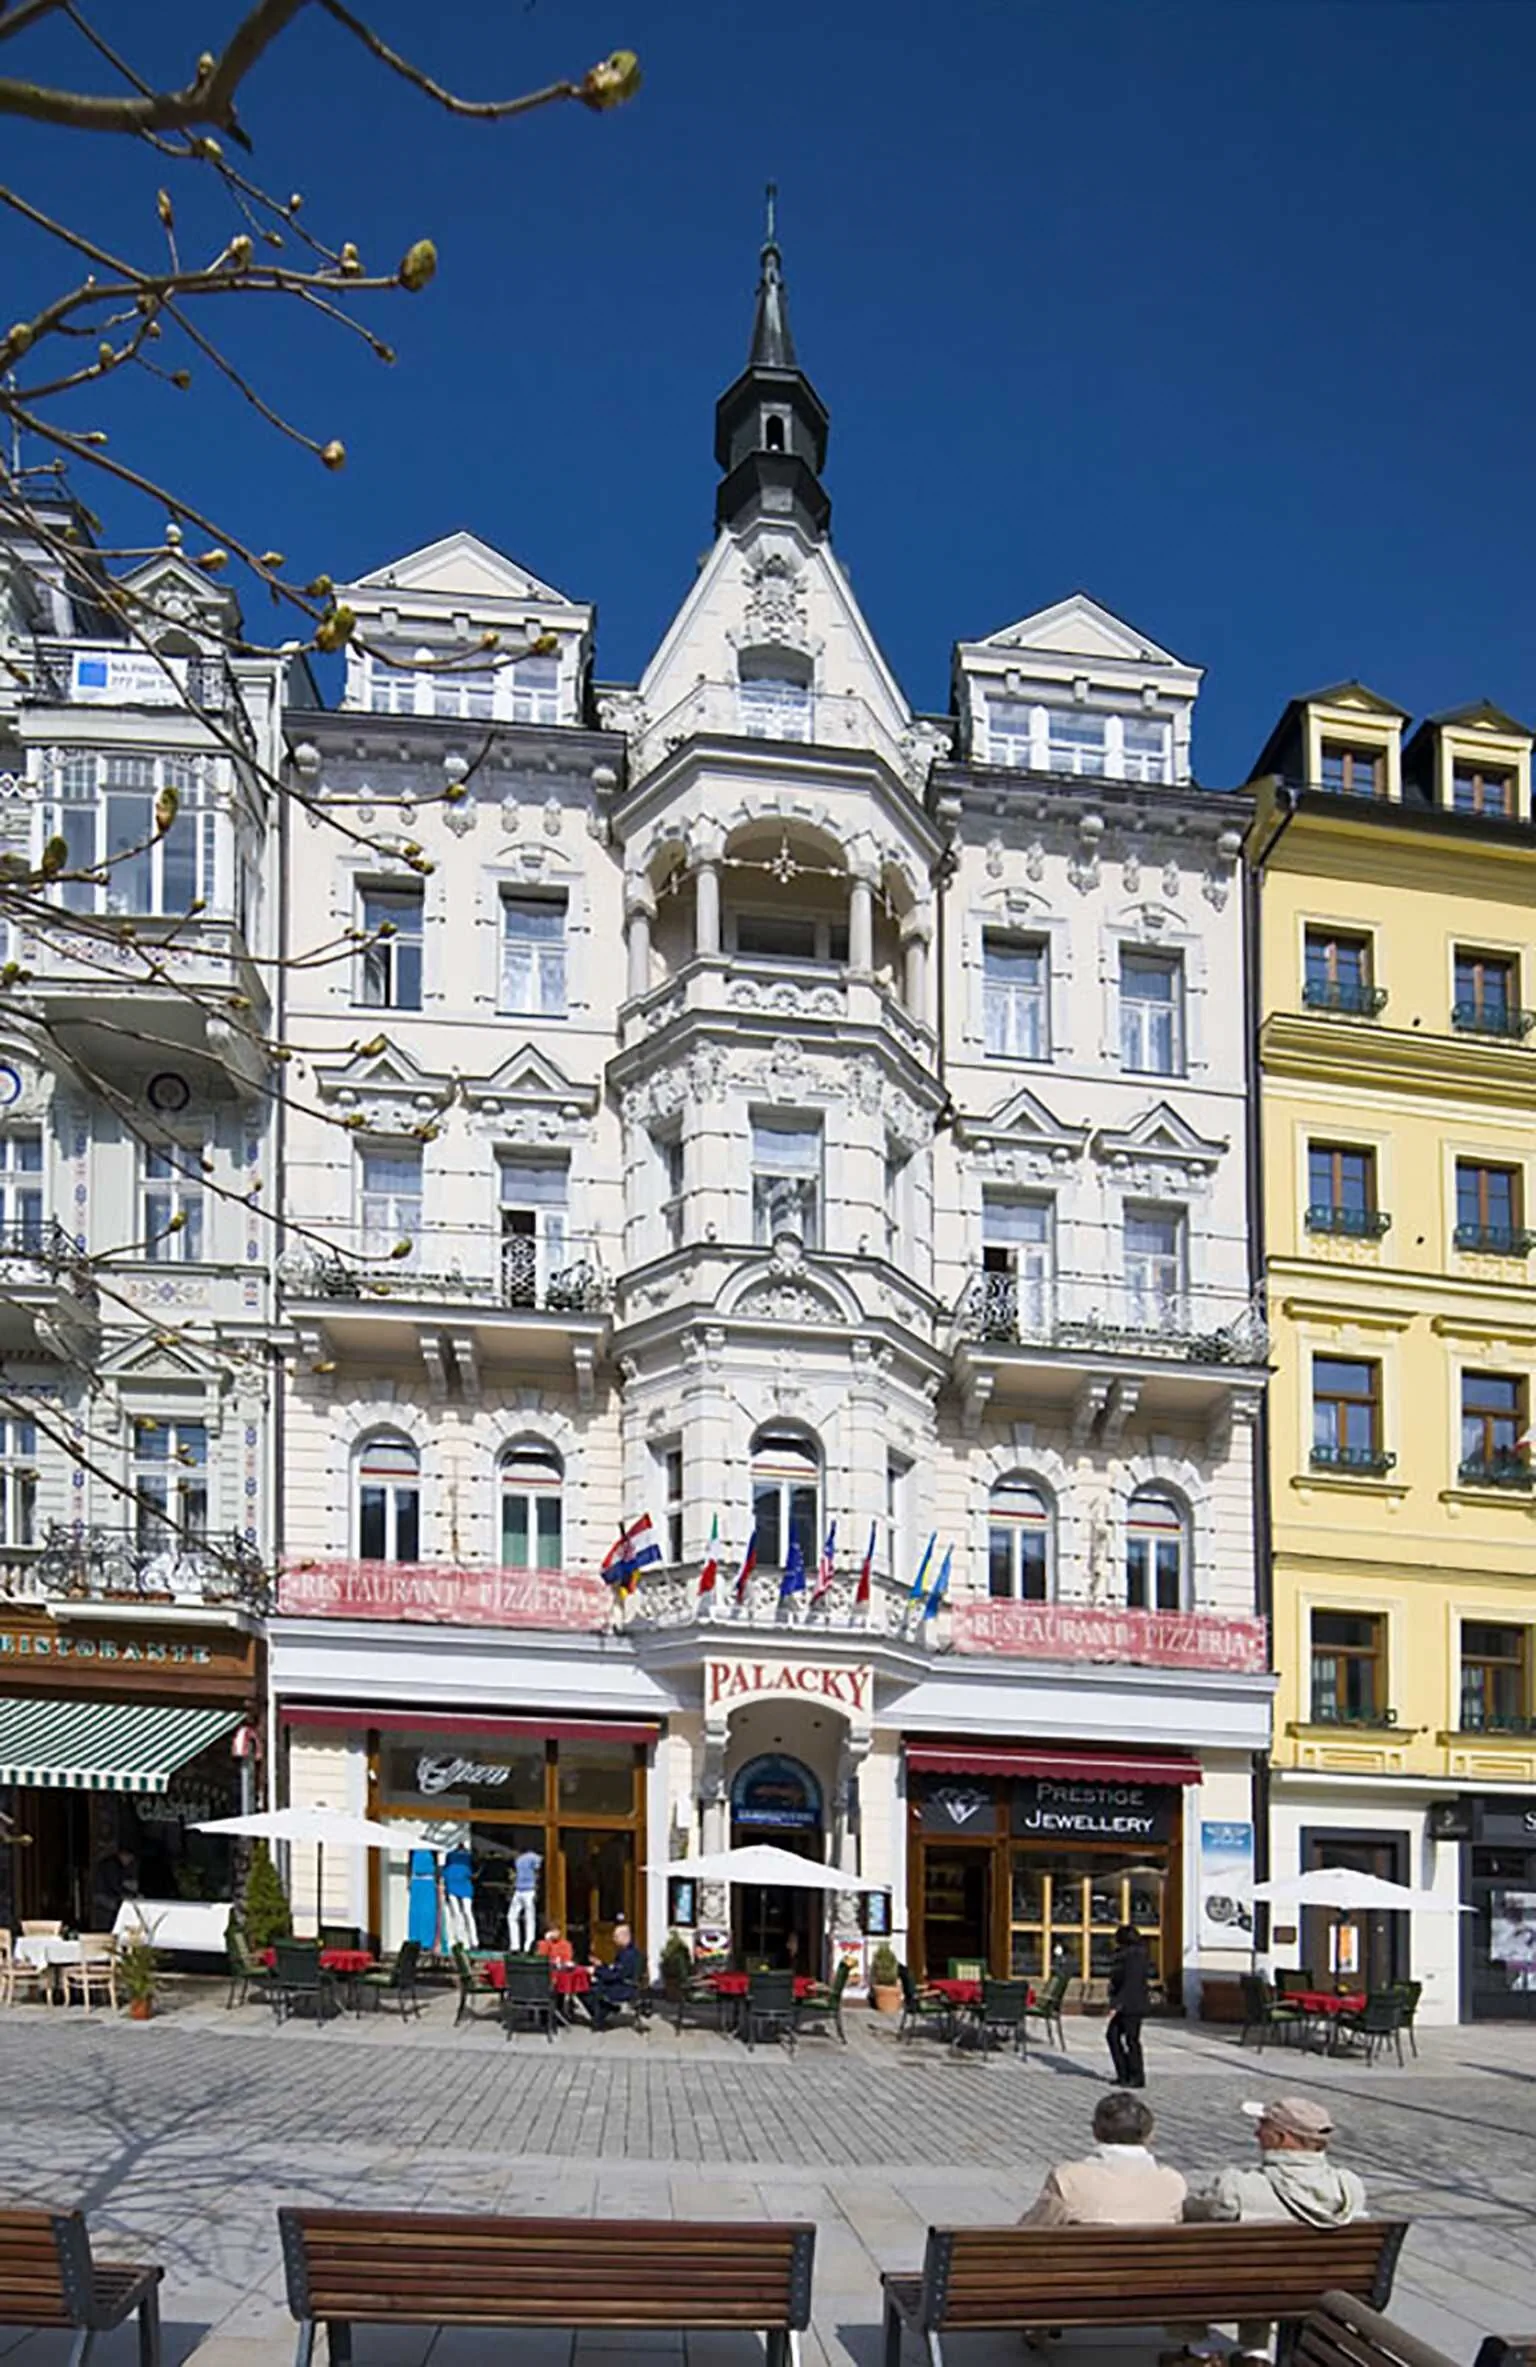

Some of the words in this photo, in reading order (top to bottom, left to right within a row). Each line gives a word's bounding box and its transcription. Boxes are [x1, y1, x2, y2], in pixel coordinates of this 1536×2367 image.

[300, 1573, 460, 1609] RESTAURANT
[0, 1633, 212, 1664] RISTORANTE
[974, 1613, 1129, 1648] RESTAURANT
[1144, 1624, 1247, 1658] PIZZERIA
[710, 1662, 869, 1711] PALACKÝ
[1037, 1782, 1145, 1806] PRESTIGE
[1025, 1809, 1154, 1833] JEWELLERY
